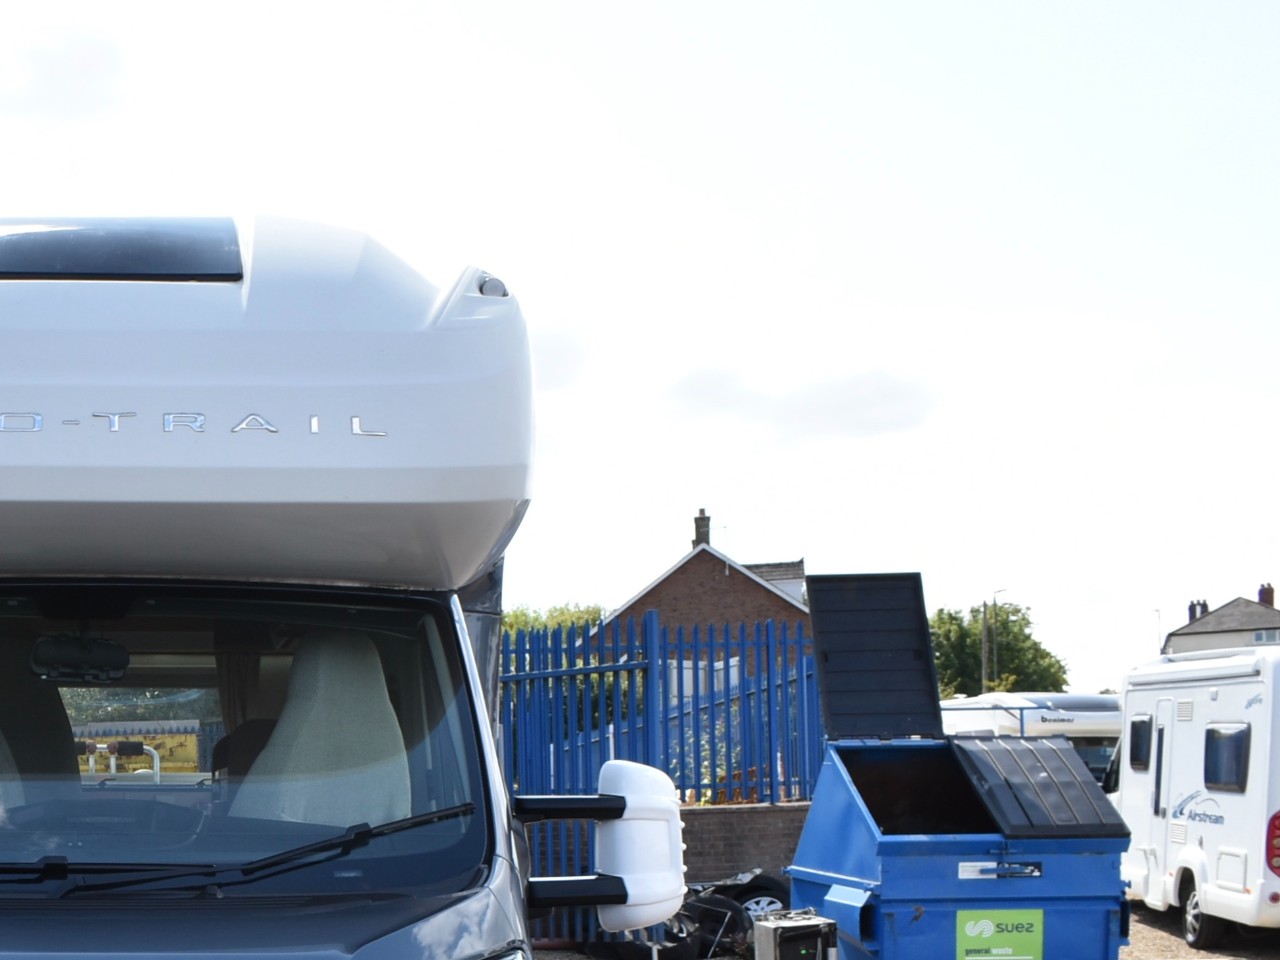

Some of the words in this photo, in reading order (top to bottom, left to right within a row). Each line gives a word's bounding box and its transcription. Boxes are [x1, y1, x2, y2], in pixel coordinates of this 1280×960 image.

[1187, 809, 1225, 825] Airstream
[995, 922, 1034, 933] suez
[964, 946, 991, 956] general
